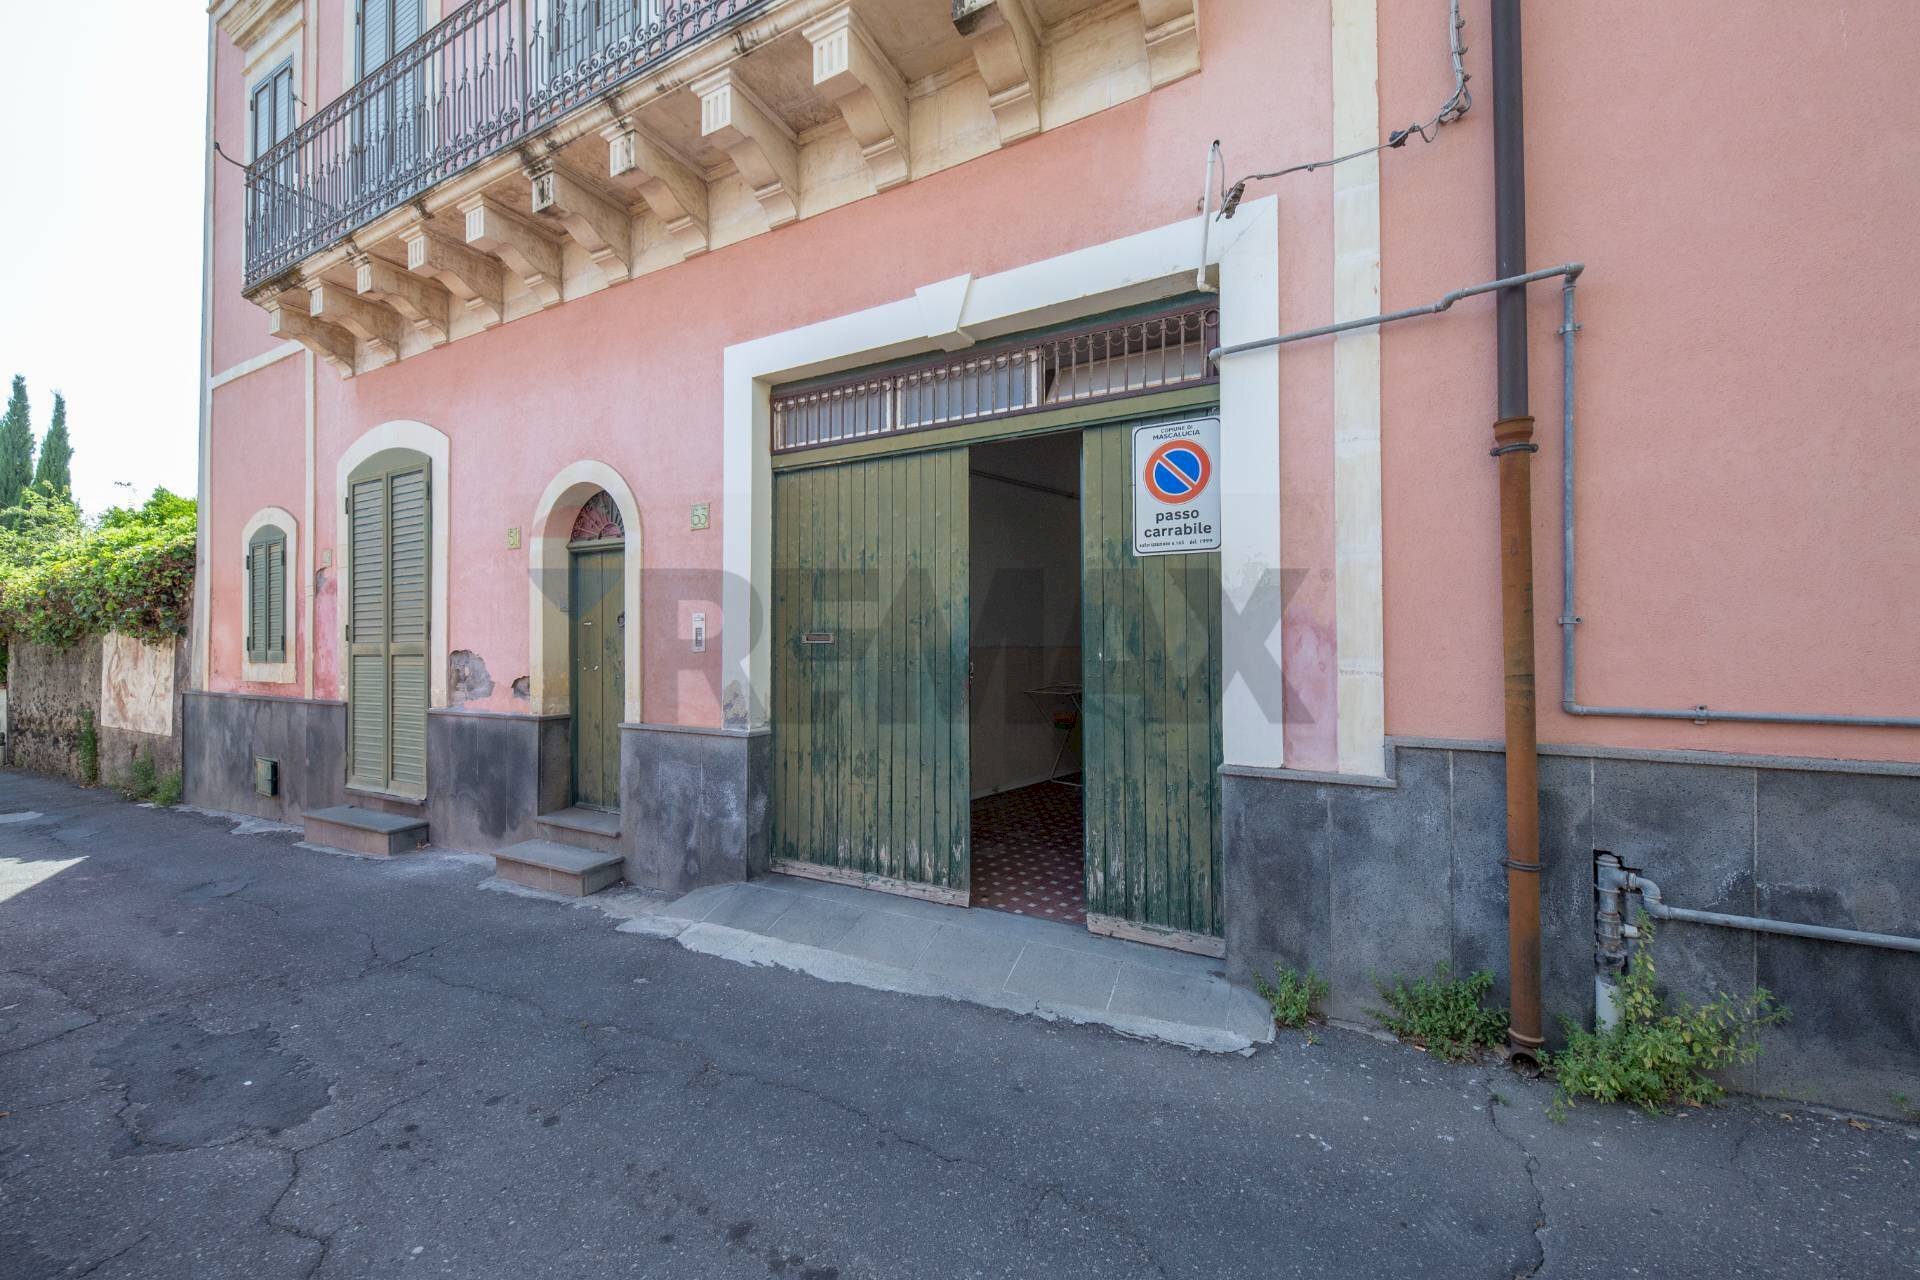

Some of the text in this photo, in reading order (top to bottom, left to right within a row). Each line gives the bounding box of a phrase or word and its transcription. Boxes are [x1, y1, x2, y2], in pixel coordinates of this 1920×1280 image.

[1152, 429, 1200, 441] MASCALUCIA
[1160, 425, 1185, 434] COMUNE
[1156, 509, 1199, 524] passo
[1144, 521, 1212, 538] carrabile
